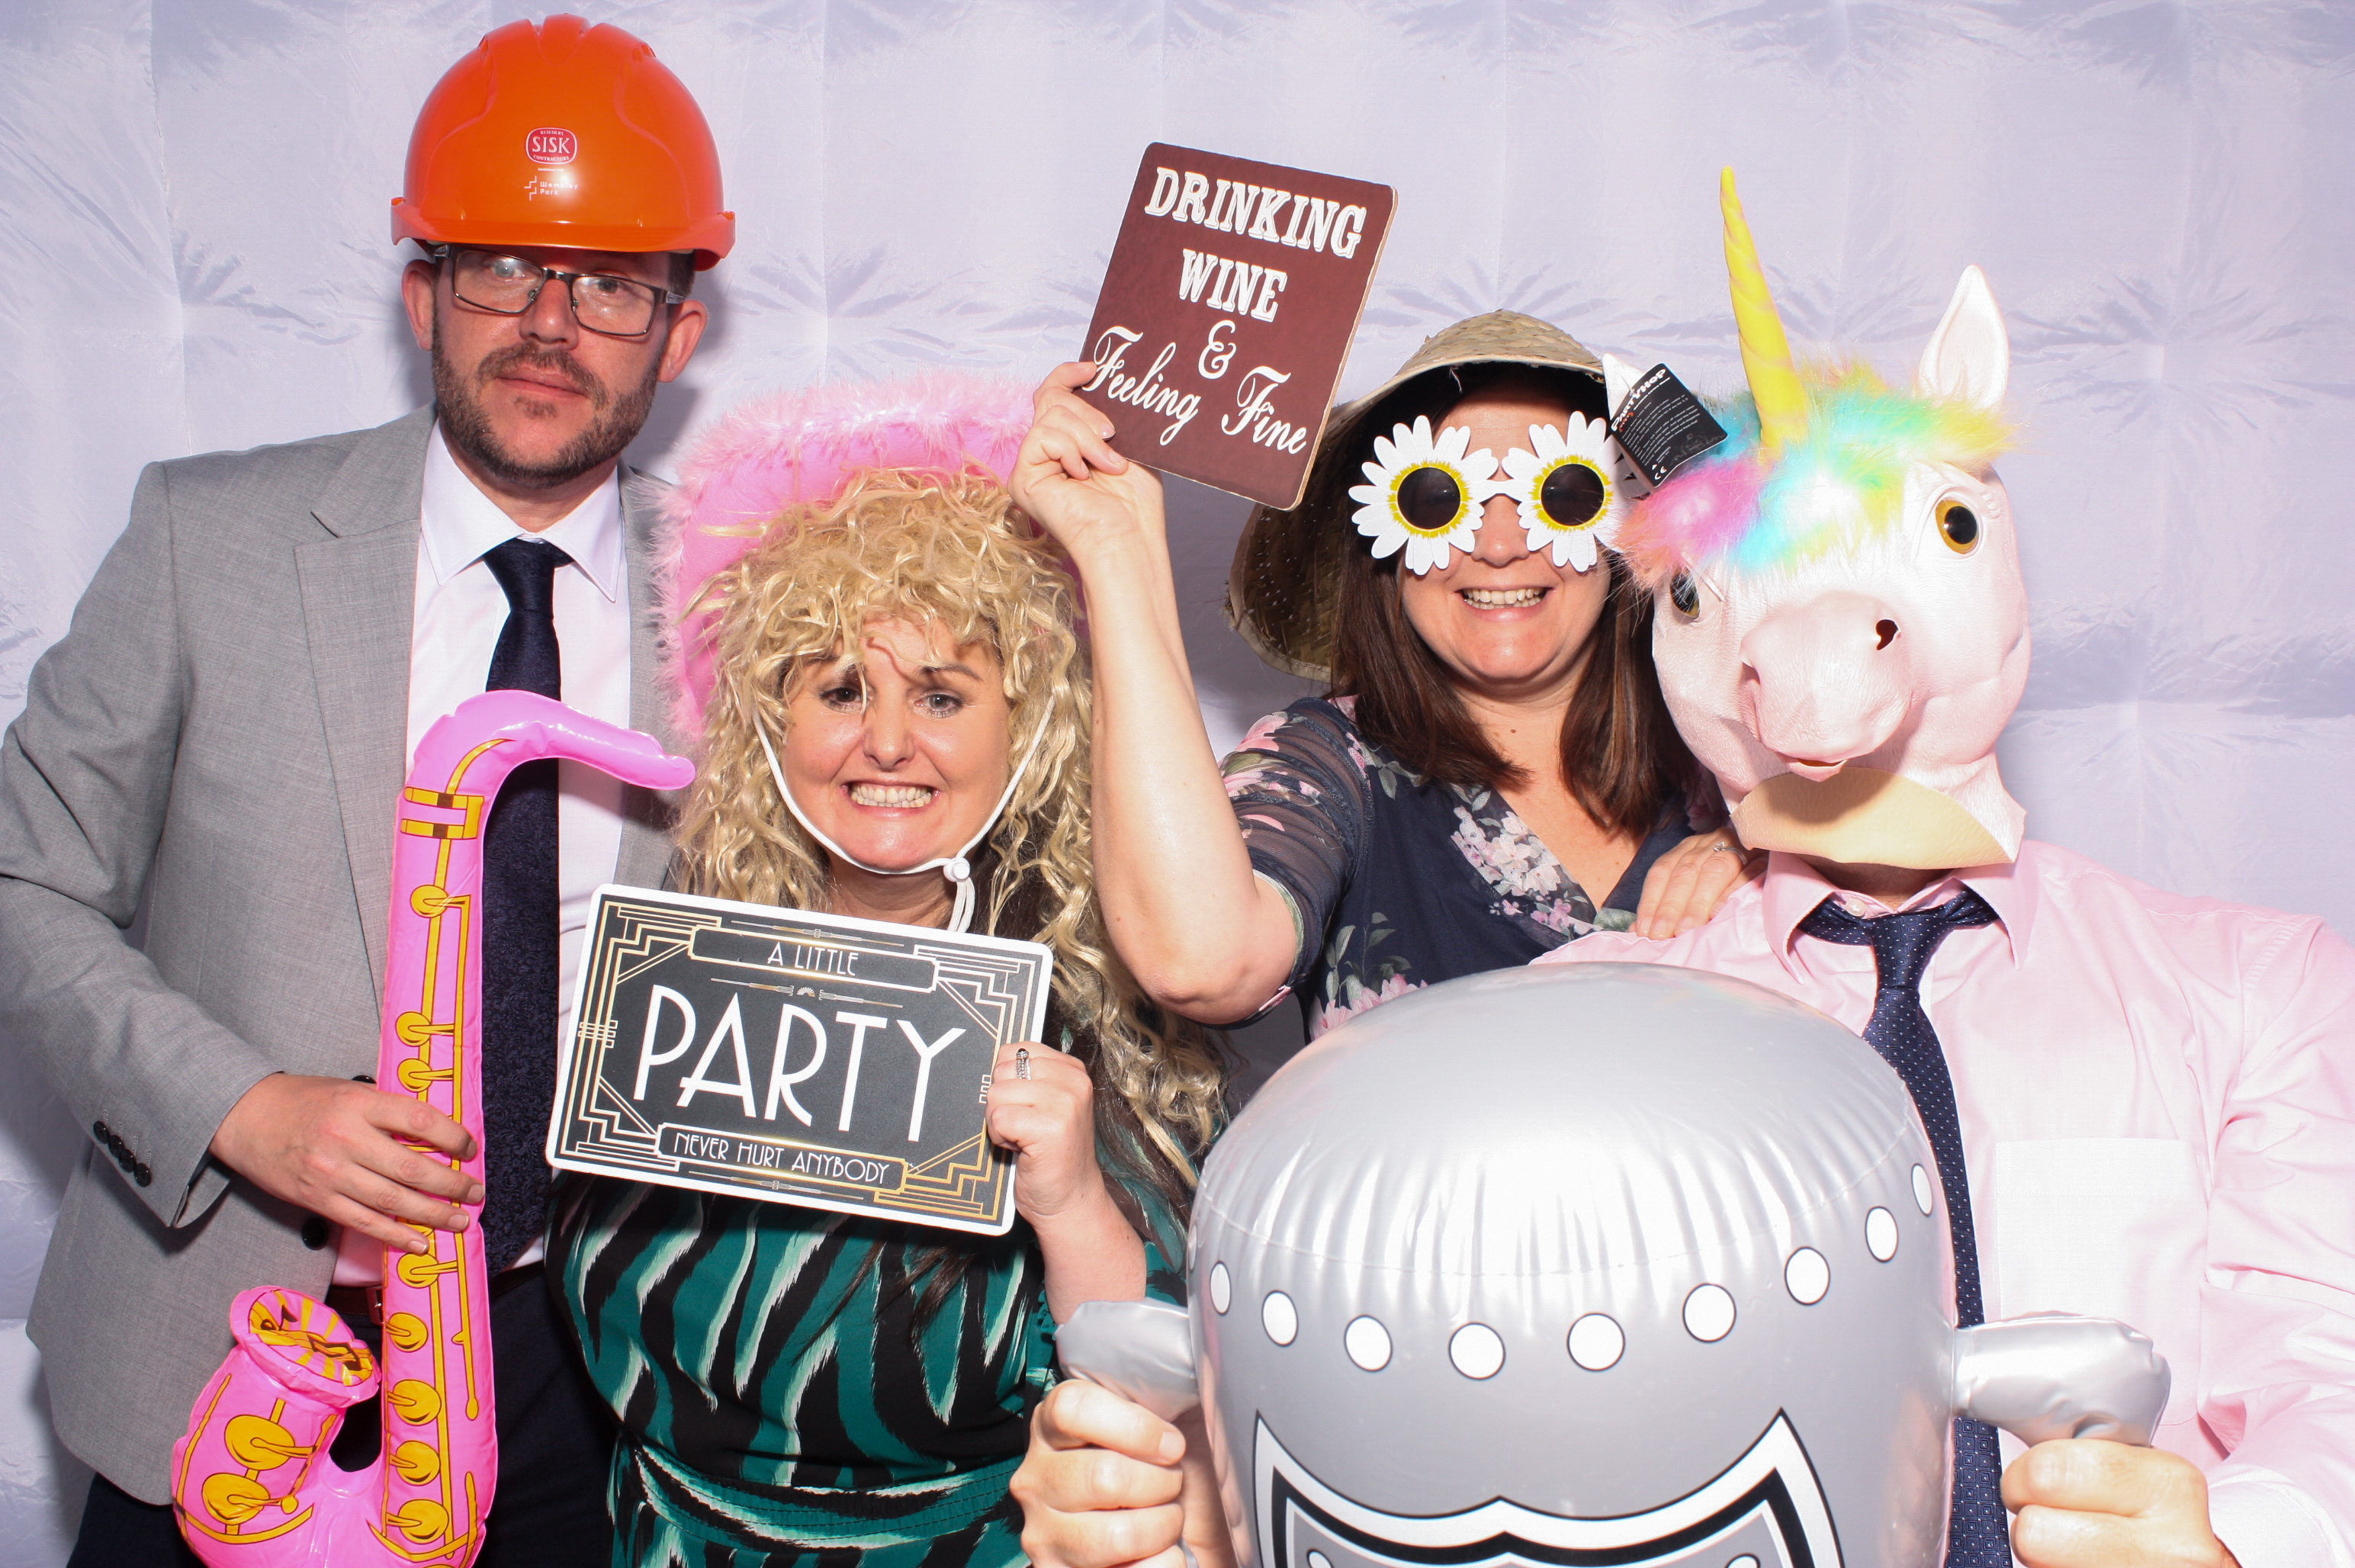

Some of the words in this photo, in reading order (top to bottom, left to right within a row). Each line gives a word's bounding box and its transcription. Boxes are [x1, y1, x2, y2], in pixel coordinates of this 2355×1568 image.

[532, 136, 570, 154] SISK
[1144, 166, 1367, 259] DRINKING
[1178, 248, 1288, 323] WINE
[1198, 320, 1237, 380] &
[1081, 325, 1202, 446] Feeling
[1221, 365, 1308, 455] Fine
[767, 942, 785, 966] A
[793, 947, 859, 976] LITTLE
[633, 984, 967, 1142] PARTY
[673, 1132, 730, 1162] NEVER
[736, 1142, 786, 1170] HURT
[791, 1150, 891, 1184] ANYBODY
